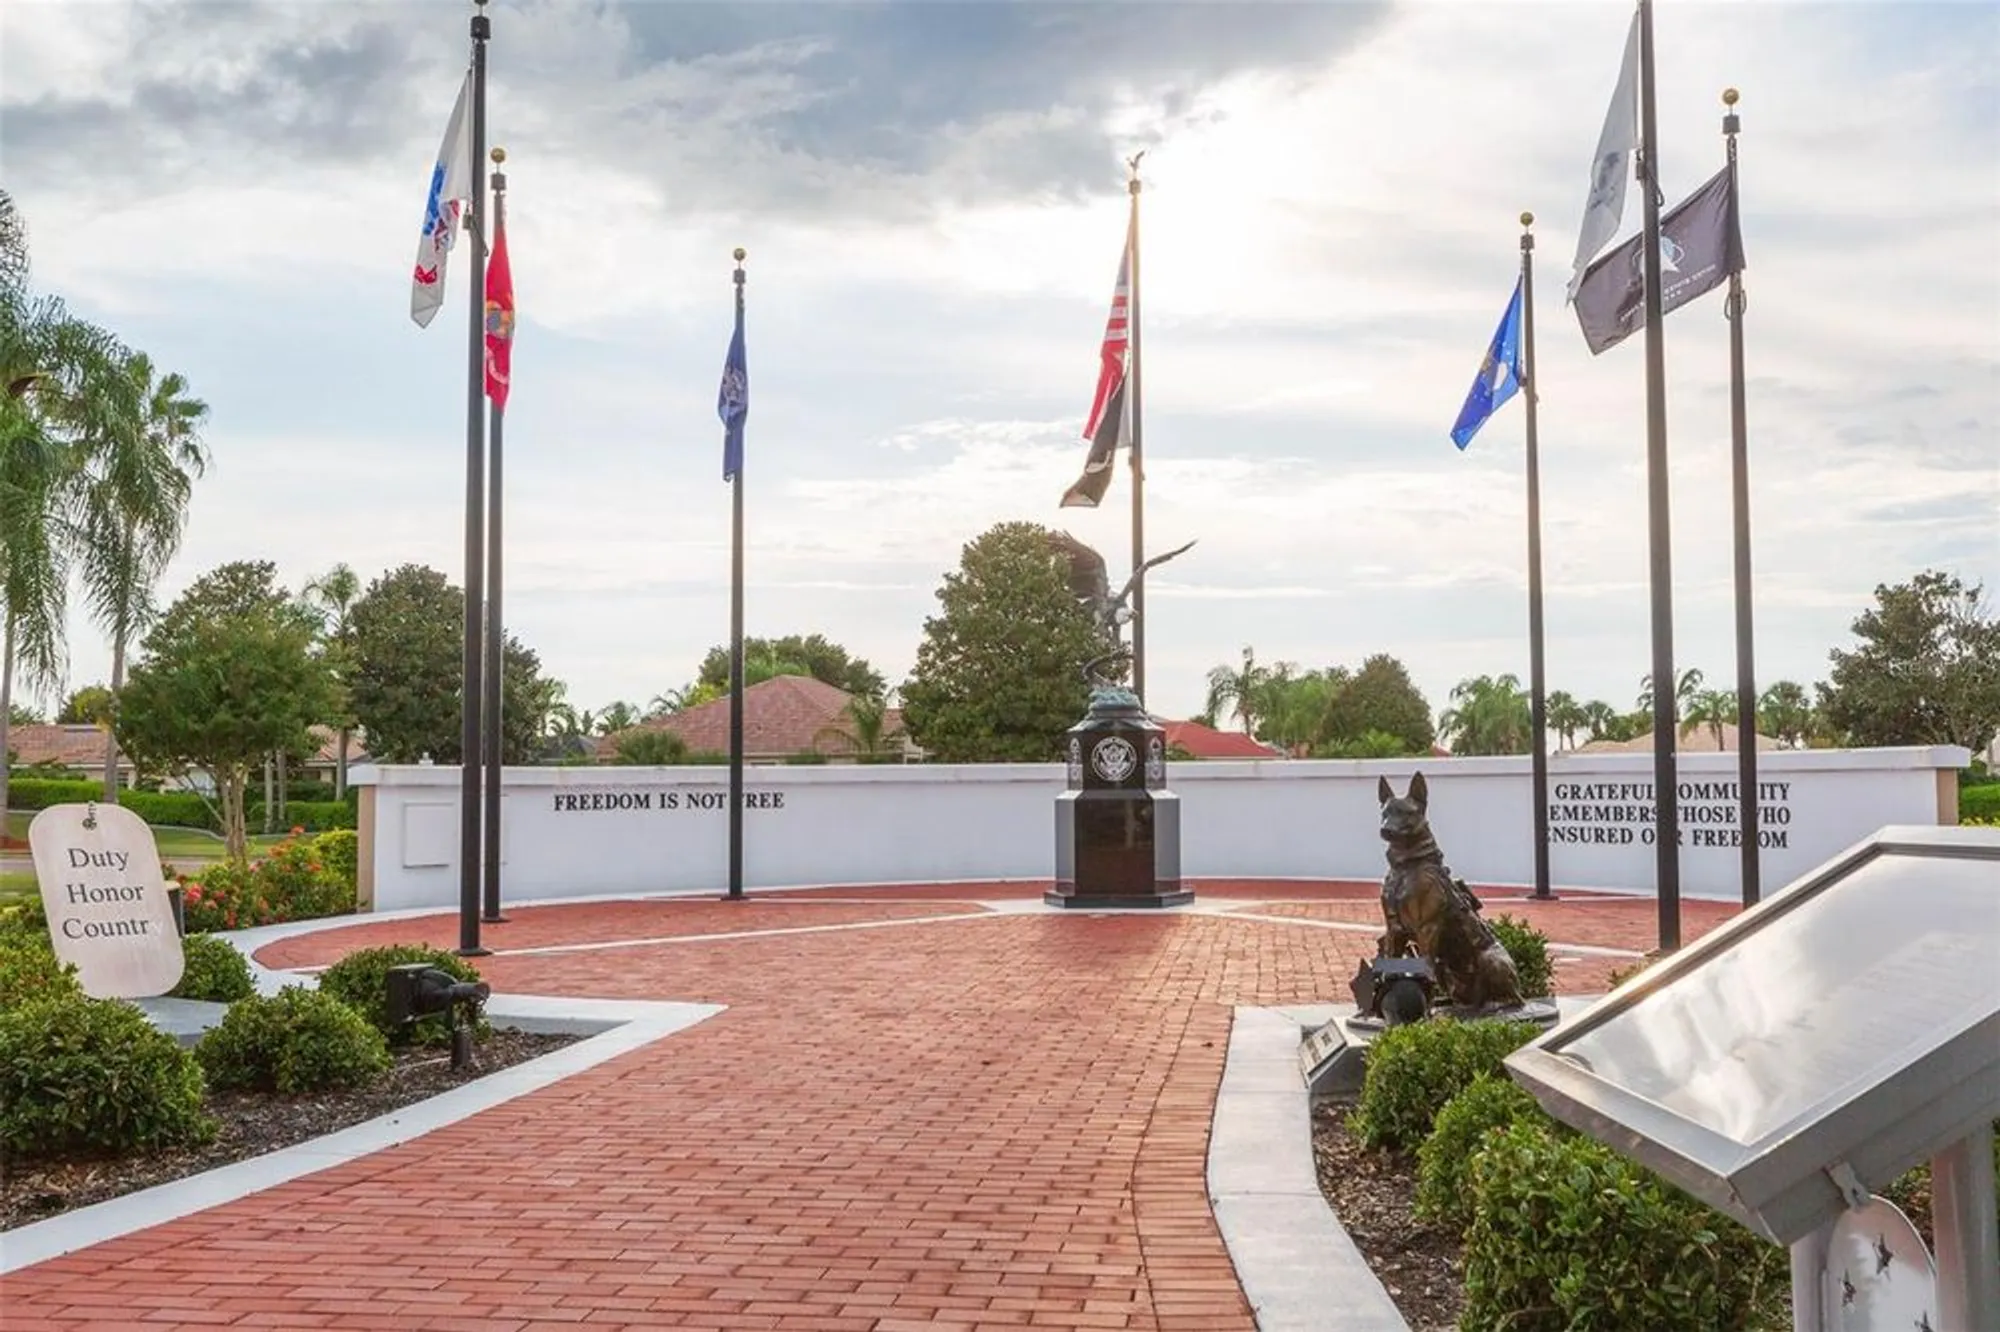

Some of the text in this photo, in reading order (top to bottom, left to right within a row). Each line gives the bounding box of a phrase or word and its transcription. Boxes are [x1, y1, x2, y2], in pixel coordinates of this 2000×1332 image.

[554, 792, 785, 811] FREEDOM IS NOT REE
[1675, 783, 1790, 801] OMMUITY
[1547, 805, 1658, 821] EMEMBERS
[1756, 807, 1791, 825] HO
[1546, 826, 1633, 844] NSURED
[1692, 829, 1786, 848] FREEOM
[66, 848, 129, 871] Duty
[66, 884, 144, 904] Honor
[62, 918, 158, 939] Countr
